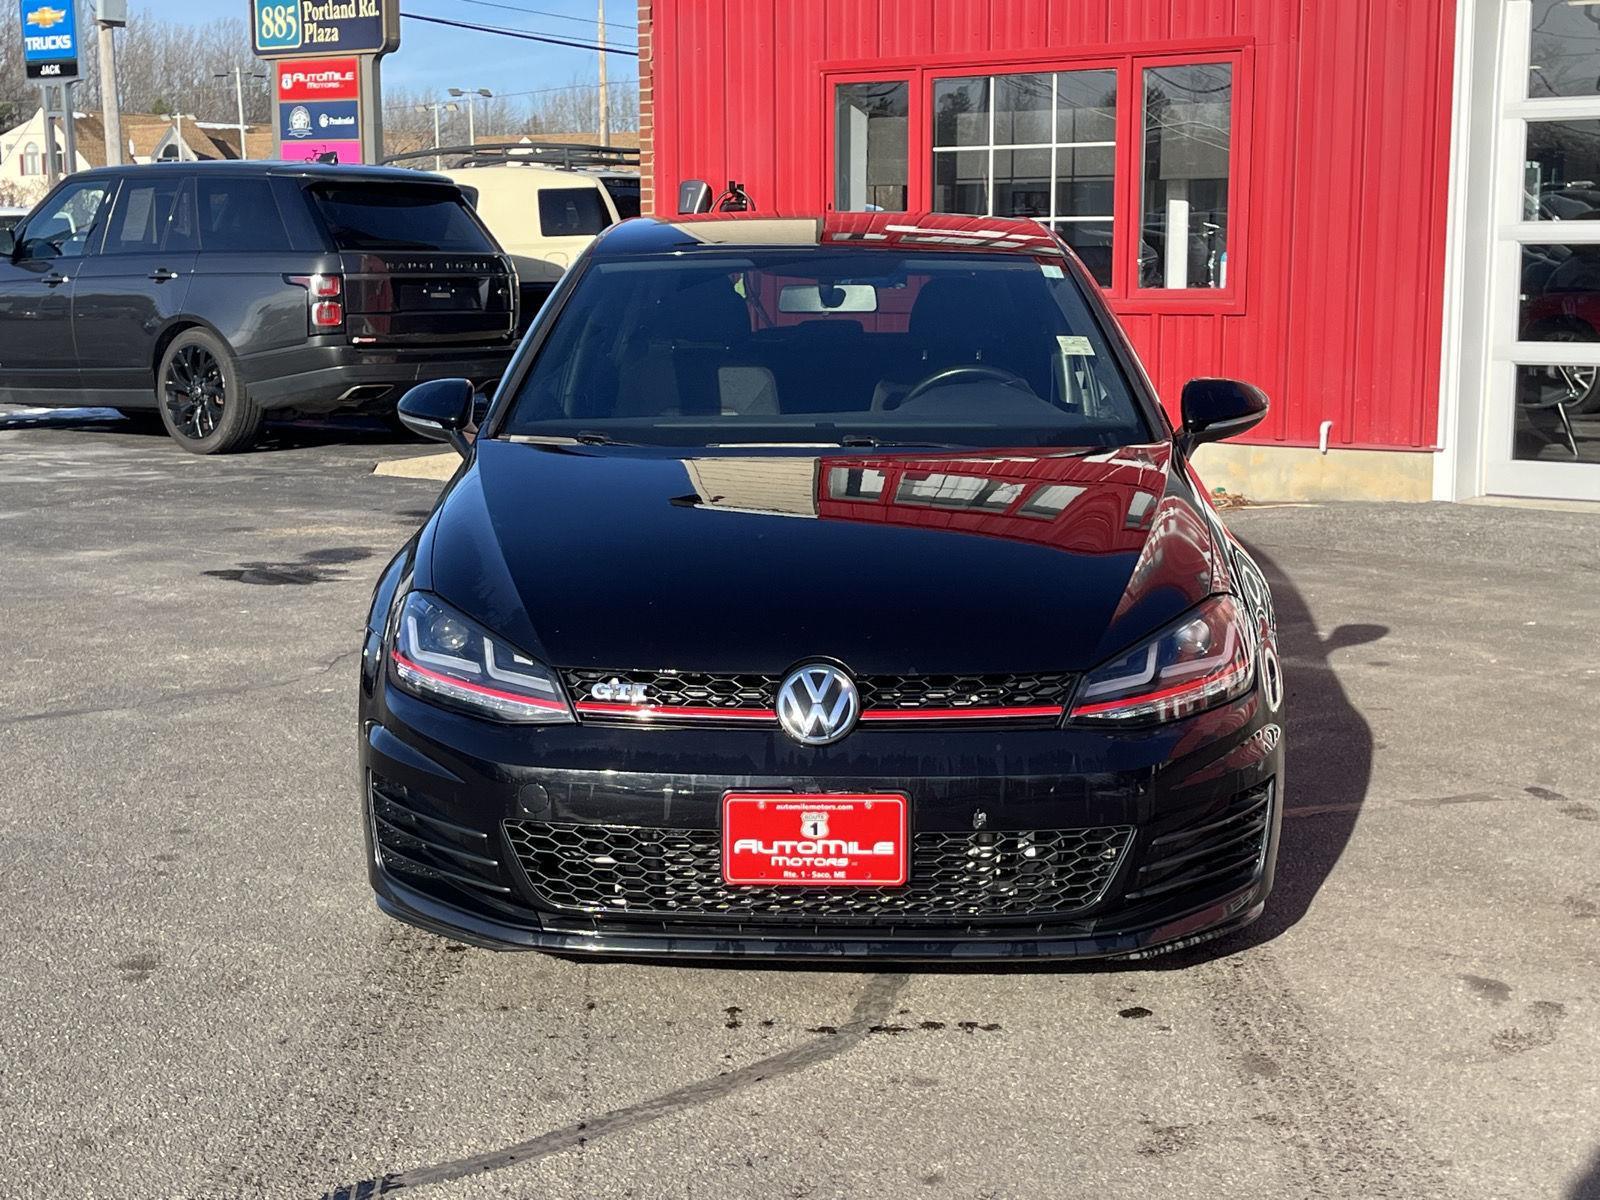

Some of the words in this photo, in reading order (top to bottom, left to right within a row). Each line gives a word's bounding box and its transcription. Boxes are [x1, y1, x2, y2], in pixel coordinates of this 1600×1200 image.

[262, 5, 297, 40] 885
[303, 0, 356, 21] Portland
[359, 0, 380, 17] Rd.
[304, 23, 339, 43] Plaza
[25, 34, 72, 51] TRUCKS
[40, 64, 61, 76] JACK
[292, 71, 354, 82] AUTOMILE
[590, 682, 648, 701] GTI
[775, 803, 854, 811] automilemotors.com
[810, 822, 818, 836] 1
[733, 839, 894, 855] AUTOMILE
[771, 856, 848, 867] MOTORS
[783, 870, 799, 879] Rte.
[811, 870, 831, 879] Saco,
[833, 870, 847, 879] ME
